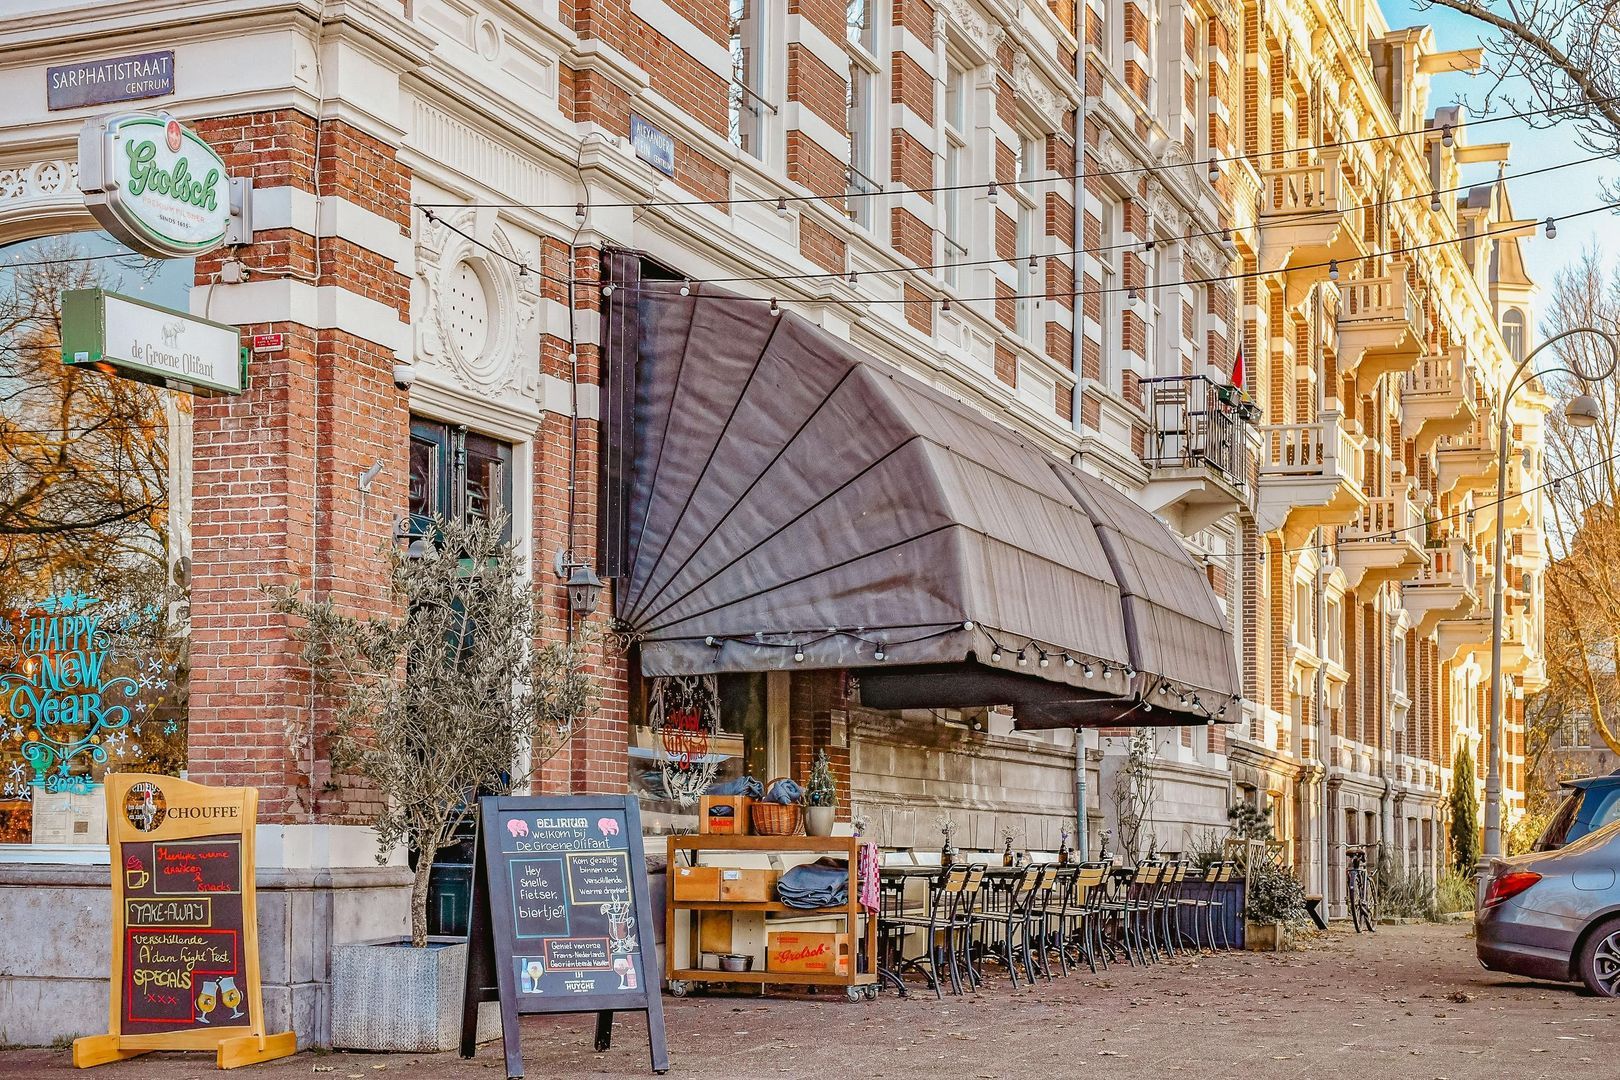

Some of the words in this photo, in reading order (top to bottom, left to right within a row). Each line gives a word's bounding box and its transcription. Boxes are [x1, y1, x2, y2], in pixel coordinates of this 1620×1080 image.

[53, 57, 169, 89] SARPHATISTRAAT
[125, 78, 169, 94] CENTRUM
[636, 122, 670, 153] ALEXANDER
[634, 136, 651, 157] PLEIN
[653, 155, 672, 172] CENTRUM
[125, 138, 219, 211] Grolsch
[159, 214, 176, 224] SINDS
[131, 339, 143, 359] de
[145, 343, 180, 369] Groene
[182, 353, 215, 380] Olifant
[25, 615, 108, 652] HAPPY
[167, 806, 238, 819] CHOUFFE
[536, 818, 588, 828] DELIRIUM
[573, 829, 586, 841] bij
[516, 841, 532, 851] De
[533, 841, 573, 851] Groene
[573, 837, 611, 850] Olifant
[572, 857, 588, 865] Kom
[525, 865, 541, 877] Hey
[778, 942, 825, 964] Grolsch
[133, 968, 192, 995] SPECIALS
[566, 982, 595, 990] HUYGHE
